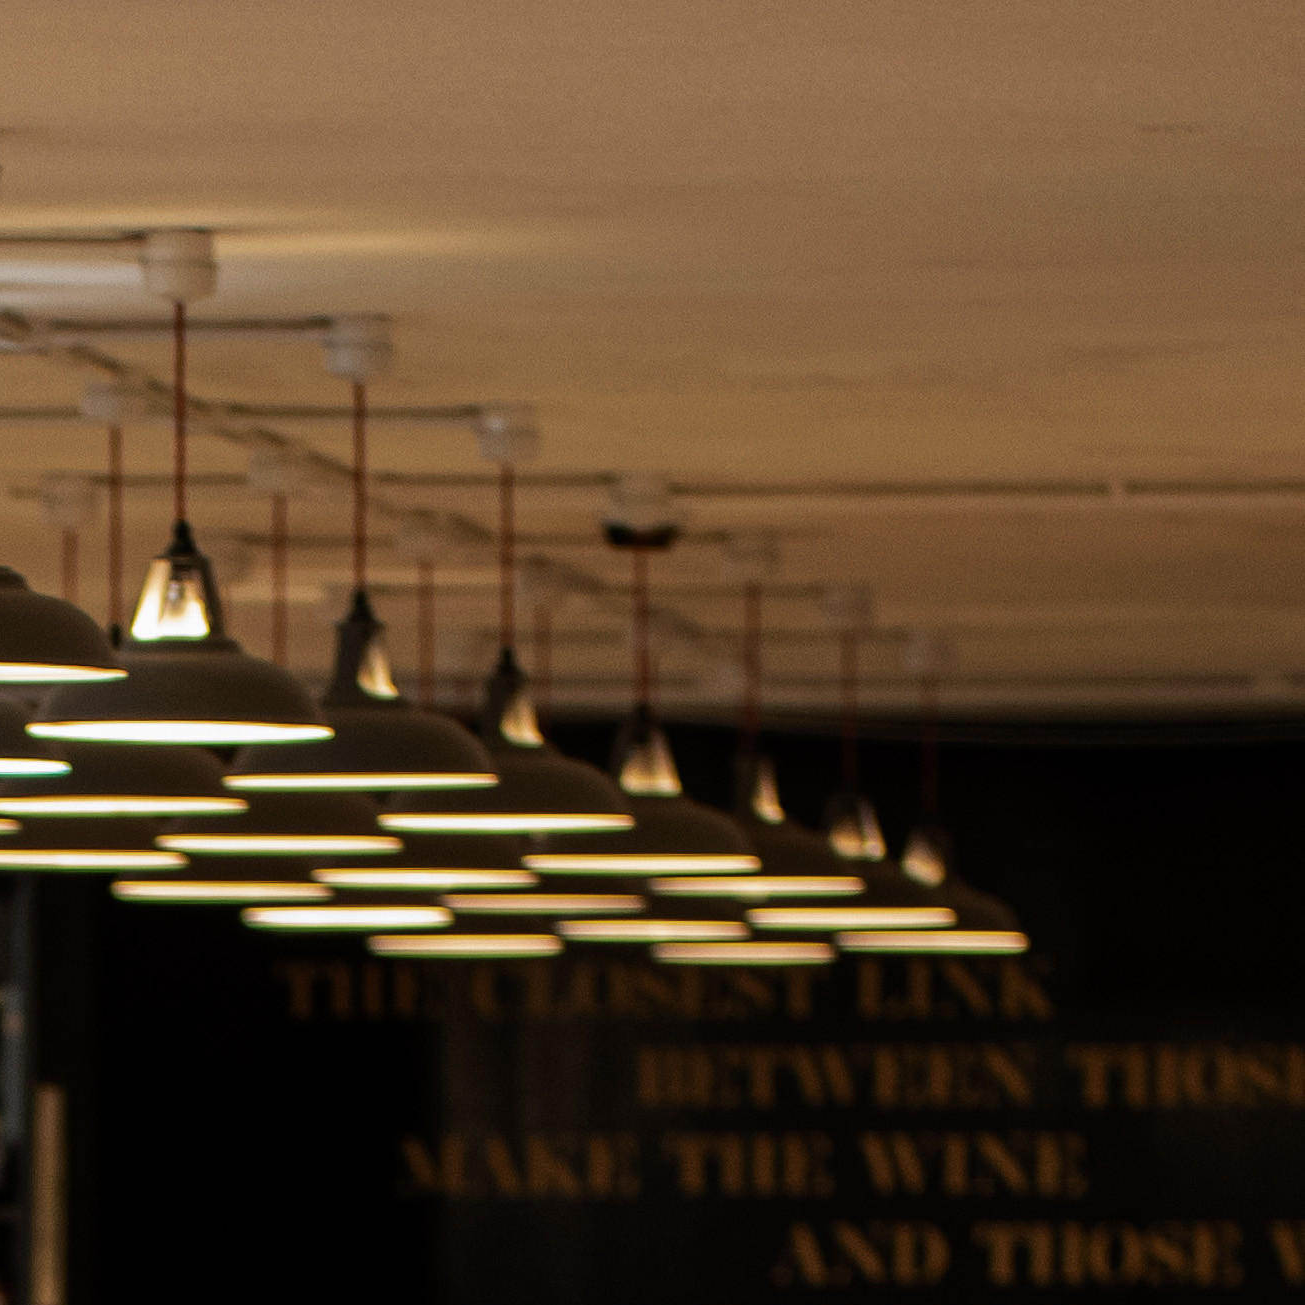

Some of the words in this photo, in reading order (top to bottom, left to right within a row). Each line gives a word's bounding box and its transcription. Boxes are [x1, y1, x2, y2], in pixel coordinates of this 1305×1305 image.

[856, 956, 1054, 1021] LINK
[636, 1044, 1036, 1107] BETWEEN
[399, 1131, 641, 1197] MAKE
[663, 1131, 835, 1197] THE
[858, 1131, 1089, 1197] WINE
[771, 1219, 952, 1287] AND
[970, 1219, 1245, 1287] THOSE
